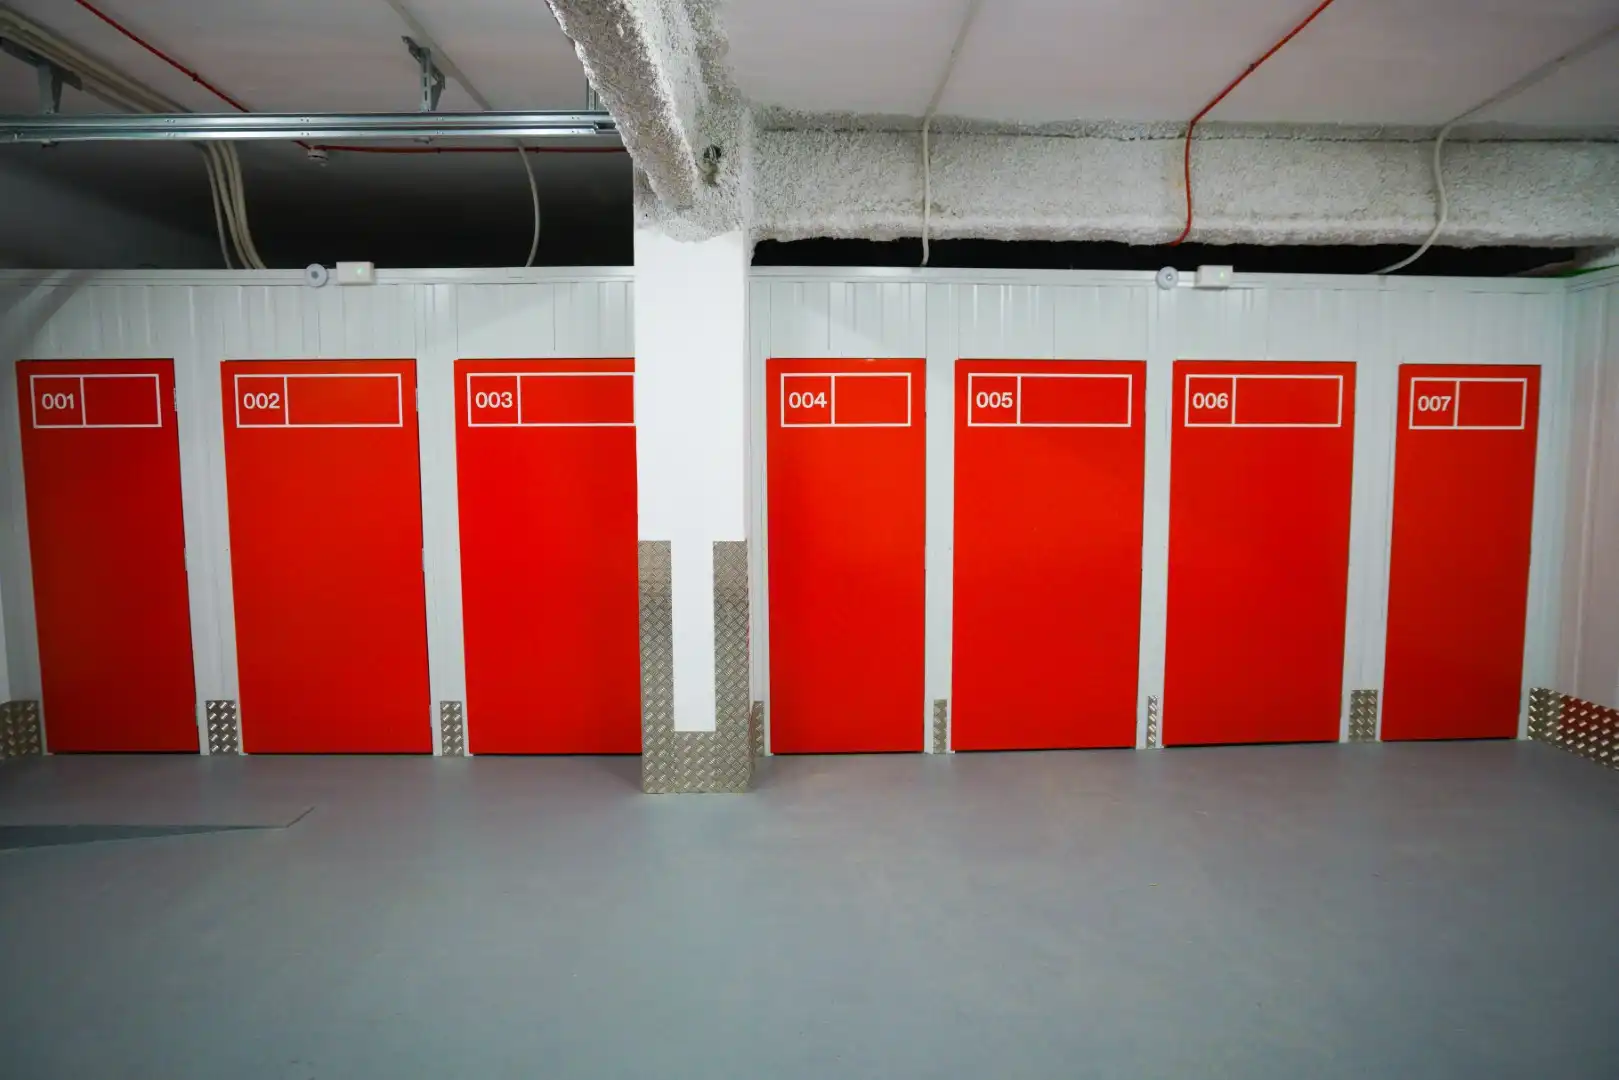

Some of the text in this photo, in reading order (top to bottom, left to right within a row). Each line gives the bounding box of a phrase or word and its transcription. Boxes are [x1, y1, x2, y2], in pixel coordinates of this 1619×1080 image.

[41, 393, 75, 409] 001
[243, 392, 281, 409] 002
[475, 391, 514, 409] 003
[788, 391, 828, 409] 004
[975, 391, 1013, 409] 005
[1192, 392, 1229, 409] 006
[1417, 395, 1452, 411] 007
